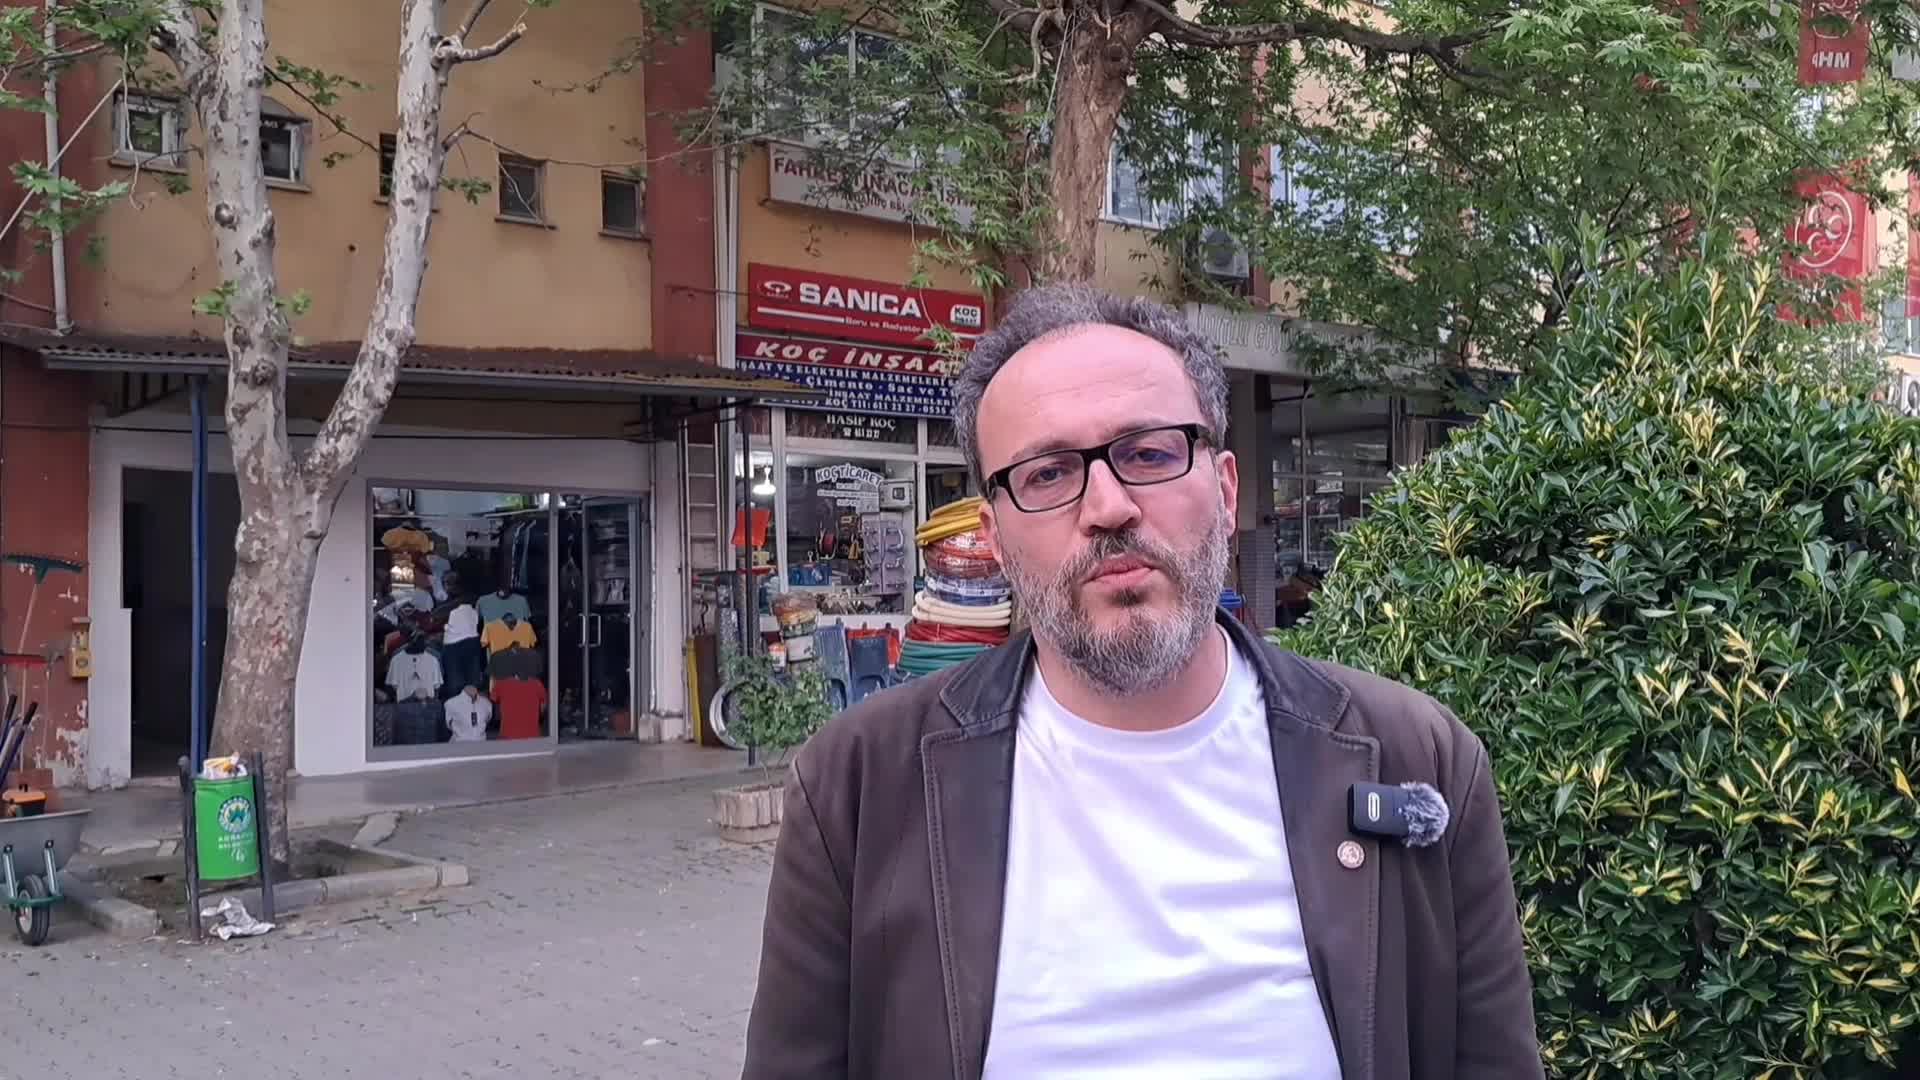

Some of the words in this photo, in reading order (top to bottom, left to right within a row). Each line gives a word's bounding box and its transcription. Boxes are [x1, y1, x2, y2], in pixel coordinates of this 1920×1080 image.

[799, 282, 922, 318] SANICA
[845, 317, 867, 327] Boru
[755, 341, 828, 363] KOÇ
[776, 363, 793, 373] VE
[796, 365, 858, 378] ELEKTRİK
[862, 371, 945, 386] MALZEMELERİ
[806, 376, 873, 391] Çimento
[888, 382, 913, 394] Sac
[919, 387, 934, 395] ve
[828, 389, 871, 400] İNŞAAT
[825, 398, 848, 409] KOÇ
[826, 414, 866, 426] HASİP
[870, 417, 896, 431] KOÇ
